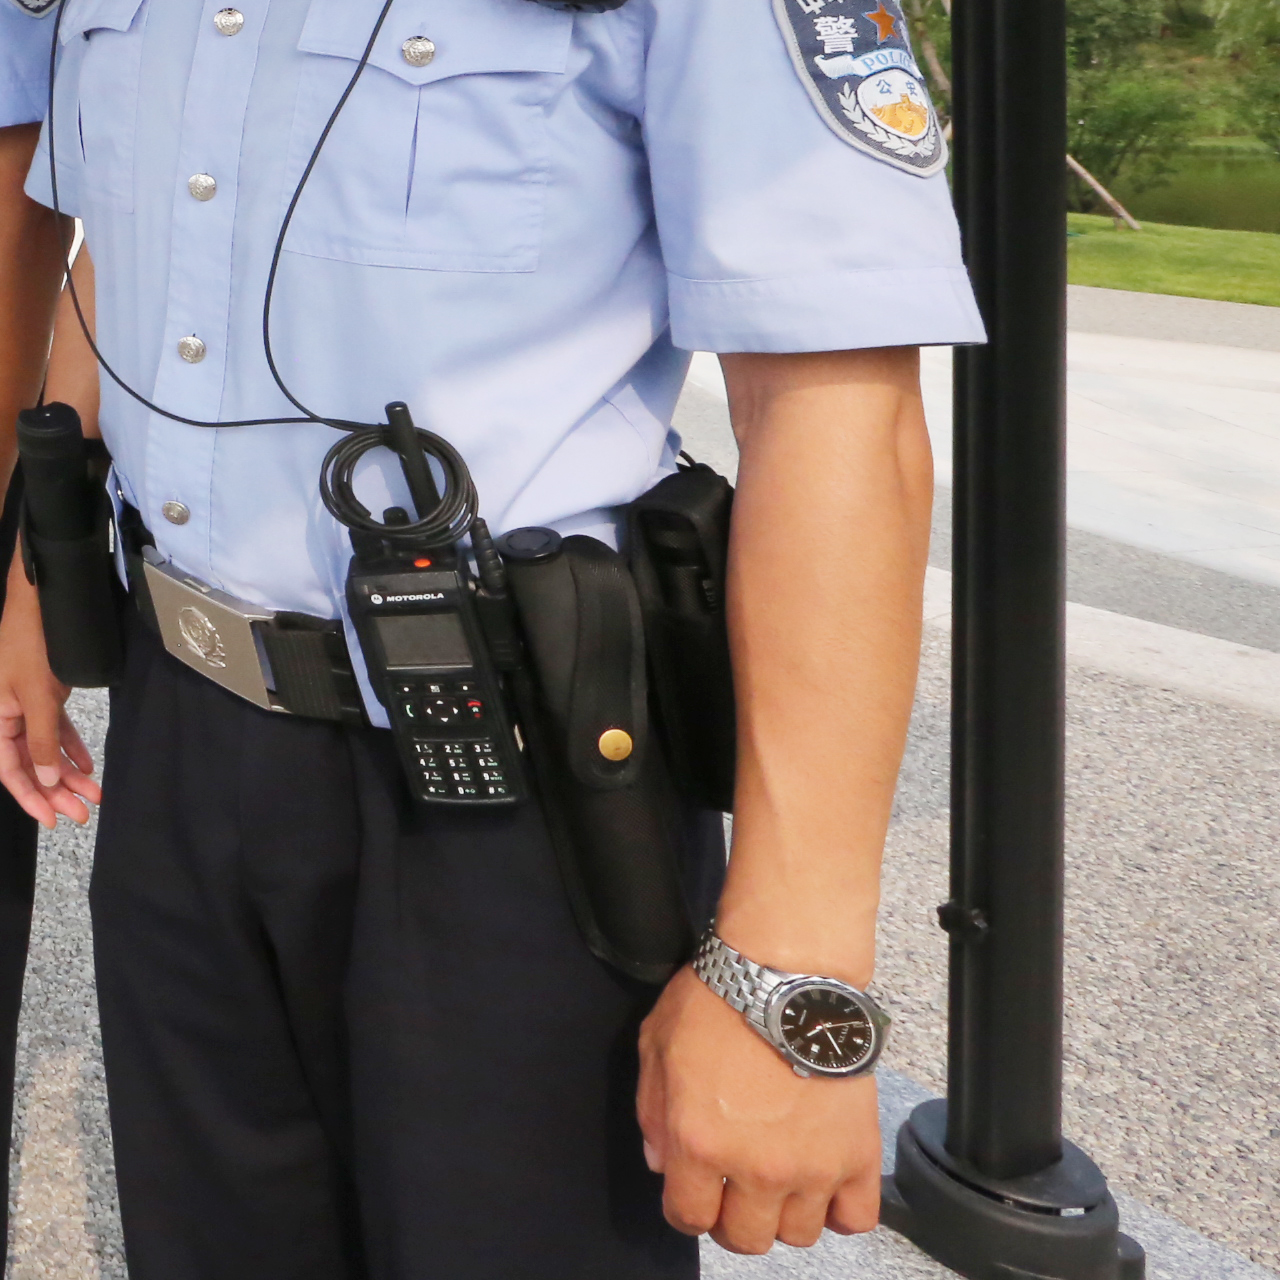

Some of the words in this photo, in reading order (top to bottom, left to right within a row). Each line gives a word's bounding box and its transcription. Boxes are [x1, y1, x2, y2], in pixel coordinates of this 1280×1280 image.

[813, 15, 858, 54] 警
[860, 51, 912, 72] POLIC
[876, 79, 918, 97] 公安
[386, 593, 444, 602] MOTOROLA
[415, 744, 421, 753] 1
[444, 745, 451, 753] 2
[474, 745, 481, 753] 3
[420, 758, 426, 766] 4
[449, 759, 455, 767] 5
[479, 758, 485, 766] 6
[423, 772, 429, 780] 7
